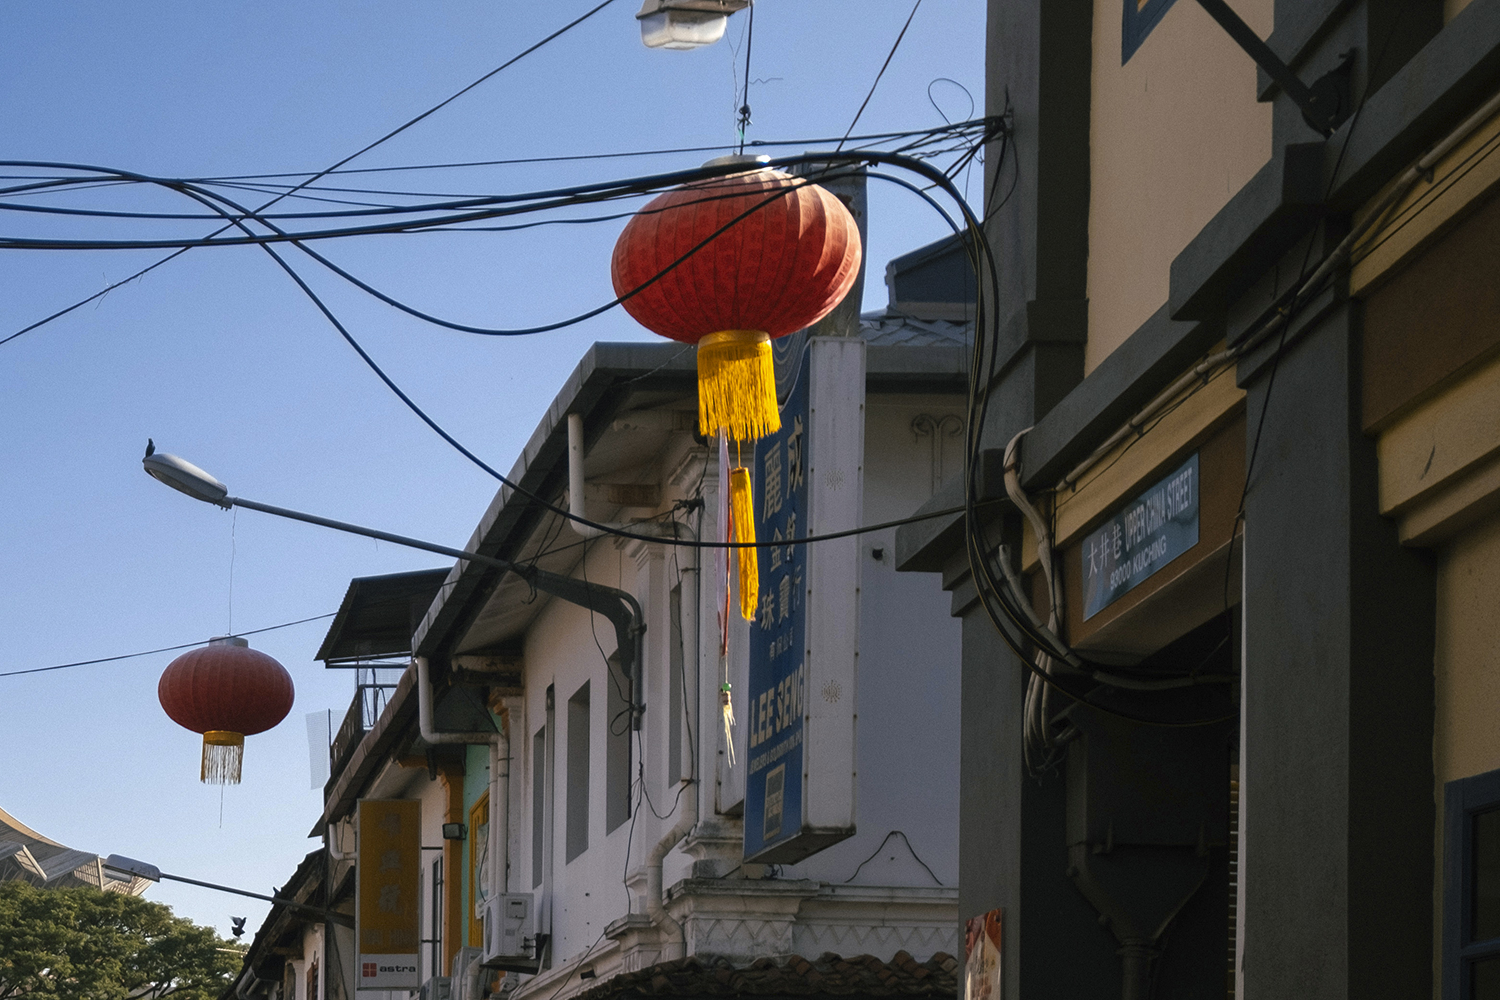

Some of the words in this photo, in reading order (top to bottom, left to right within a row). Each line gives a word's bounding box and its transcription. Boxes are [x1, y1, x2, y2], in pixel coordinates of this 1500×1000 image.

[1124, 503, 1146, 552] UPPER
[1146, 487, 1166, 534] CHINA
[1167, 466, 1193, 521] STREET
[1110, 561, 1131, 590] 93000
[1132, 535, 1167, 576] KUCHING
[750, 687, 775, 749] LEE
[380, 965, 416, 973] astra
